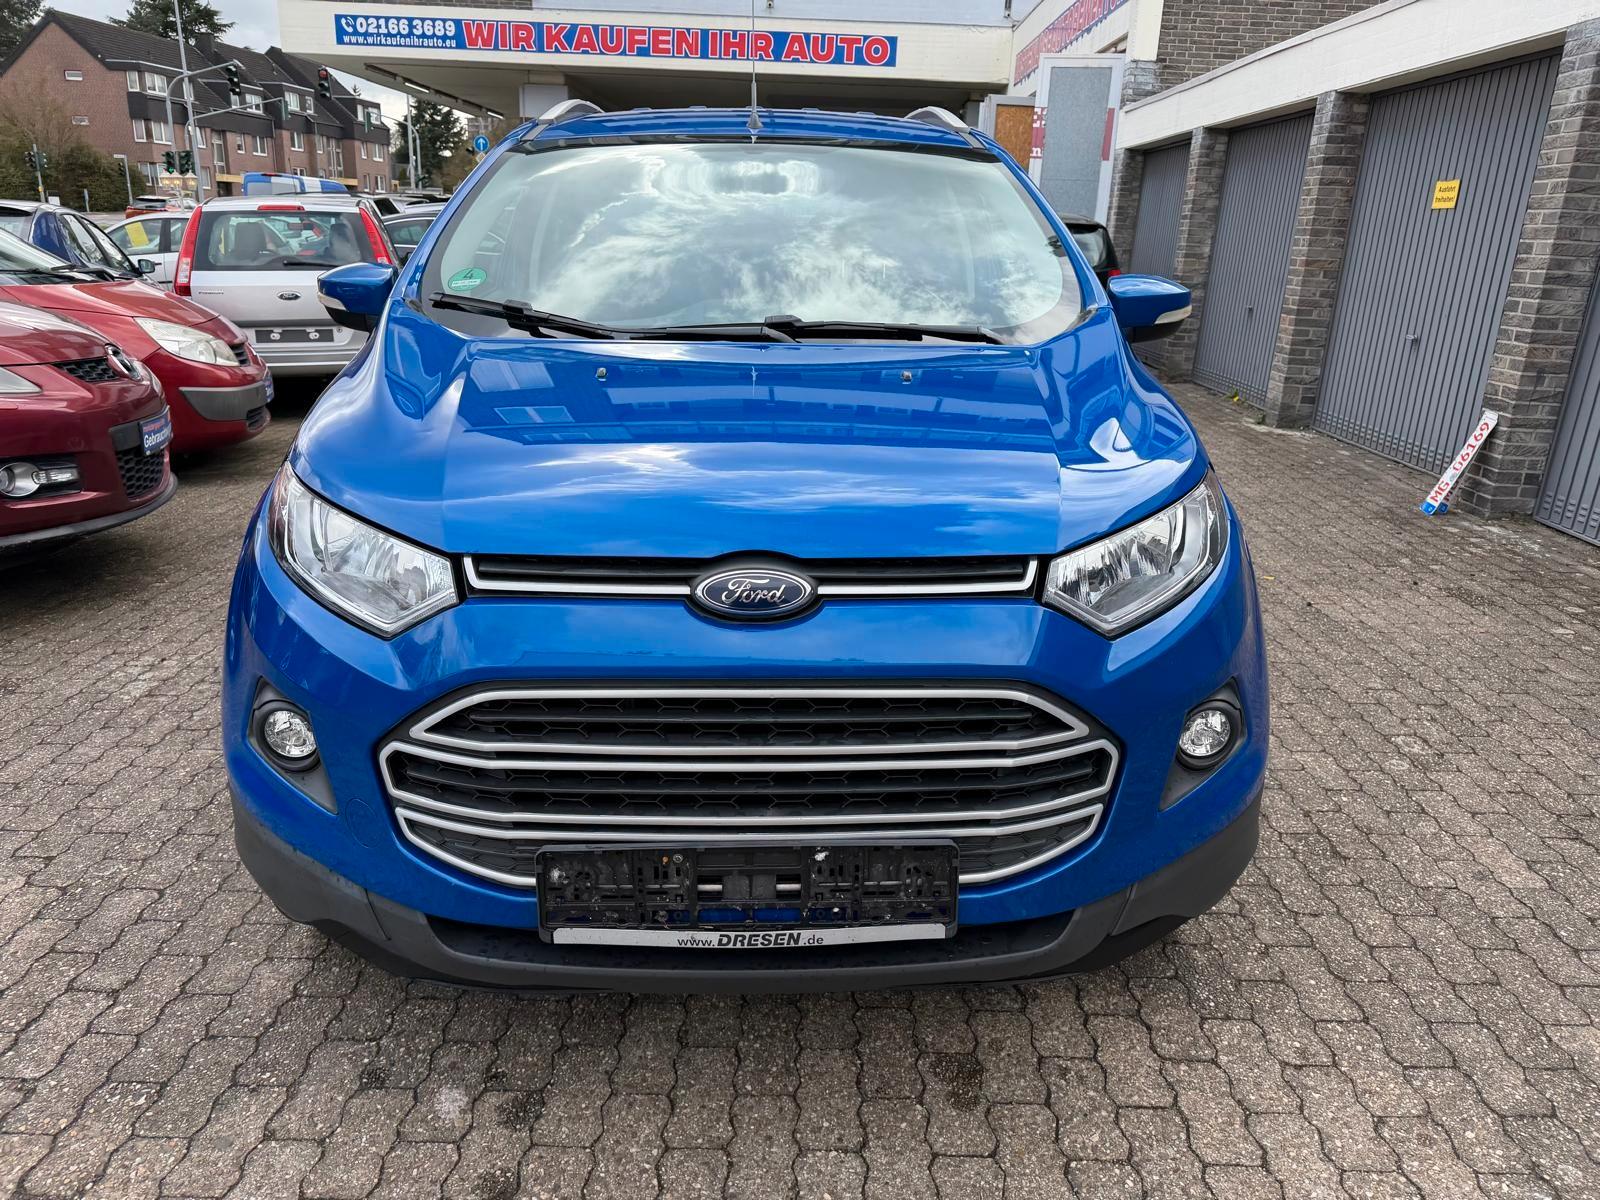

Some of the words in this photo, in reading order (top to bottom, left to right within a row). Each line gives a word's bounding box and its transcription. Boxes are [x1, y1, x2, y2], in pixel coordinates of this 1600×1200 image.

[356, 16, 409, 35] 02166
[412, 19, 456, 36] 3689
[343, 34, 457, 48] www.wirkaufenihrauto.eu
[462, 20, 536, 51] WIR
[544, 23, 700, 58] KAUFEN
[709, 30, 774, 61] IHR
[782, 33, 890, 66] AUTO
[463, 269, 475, 280] 4
[1429, 480, 1450, 503] MG
[721, 578, 786, 604] Ford
[677, 932, 824, 947] www.DRESEN.de
